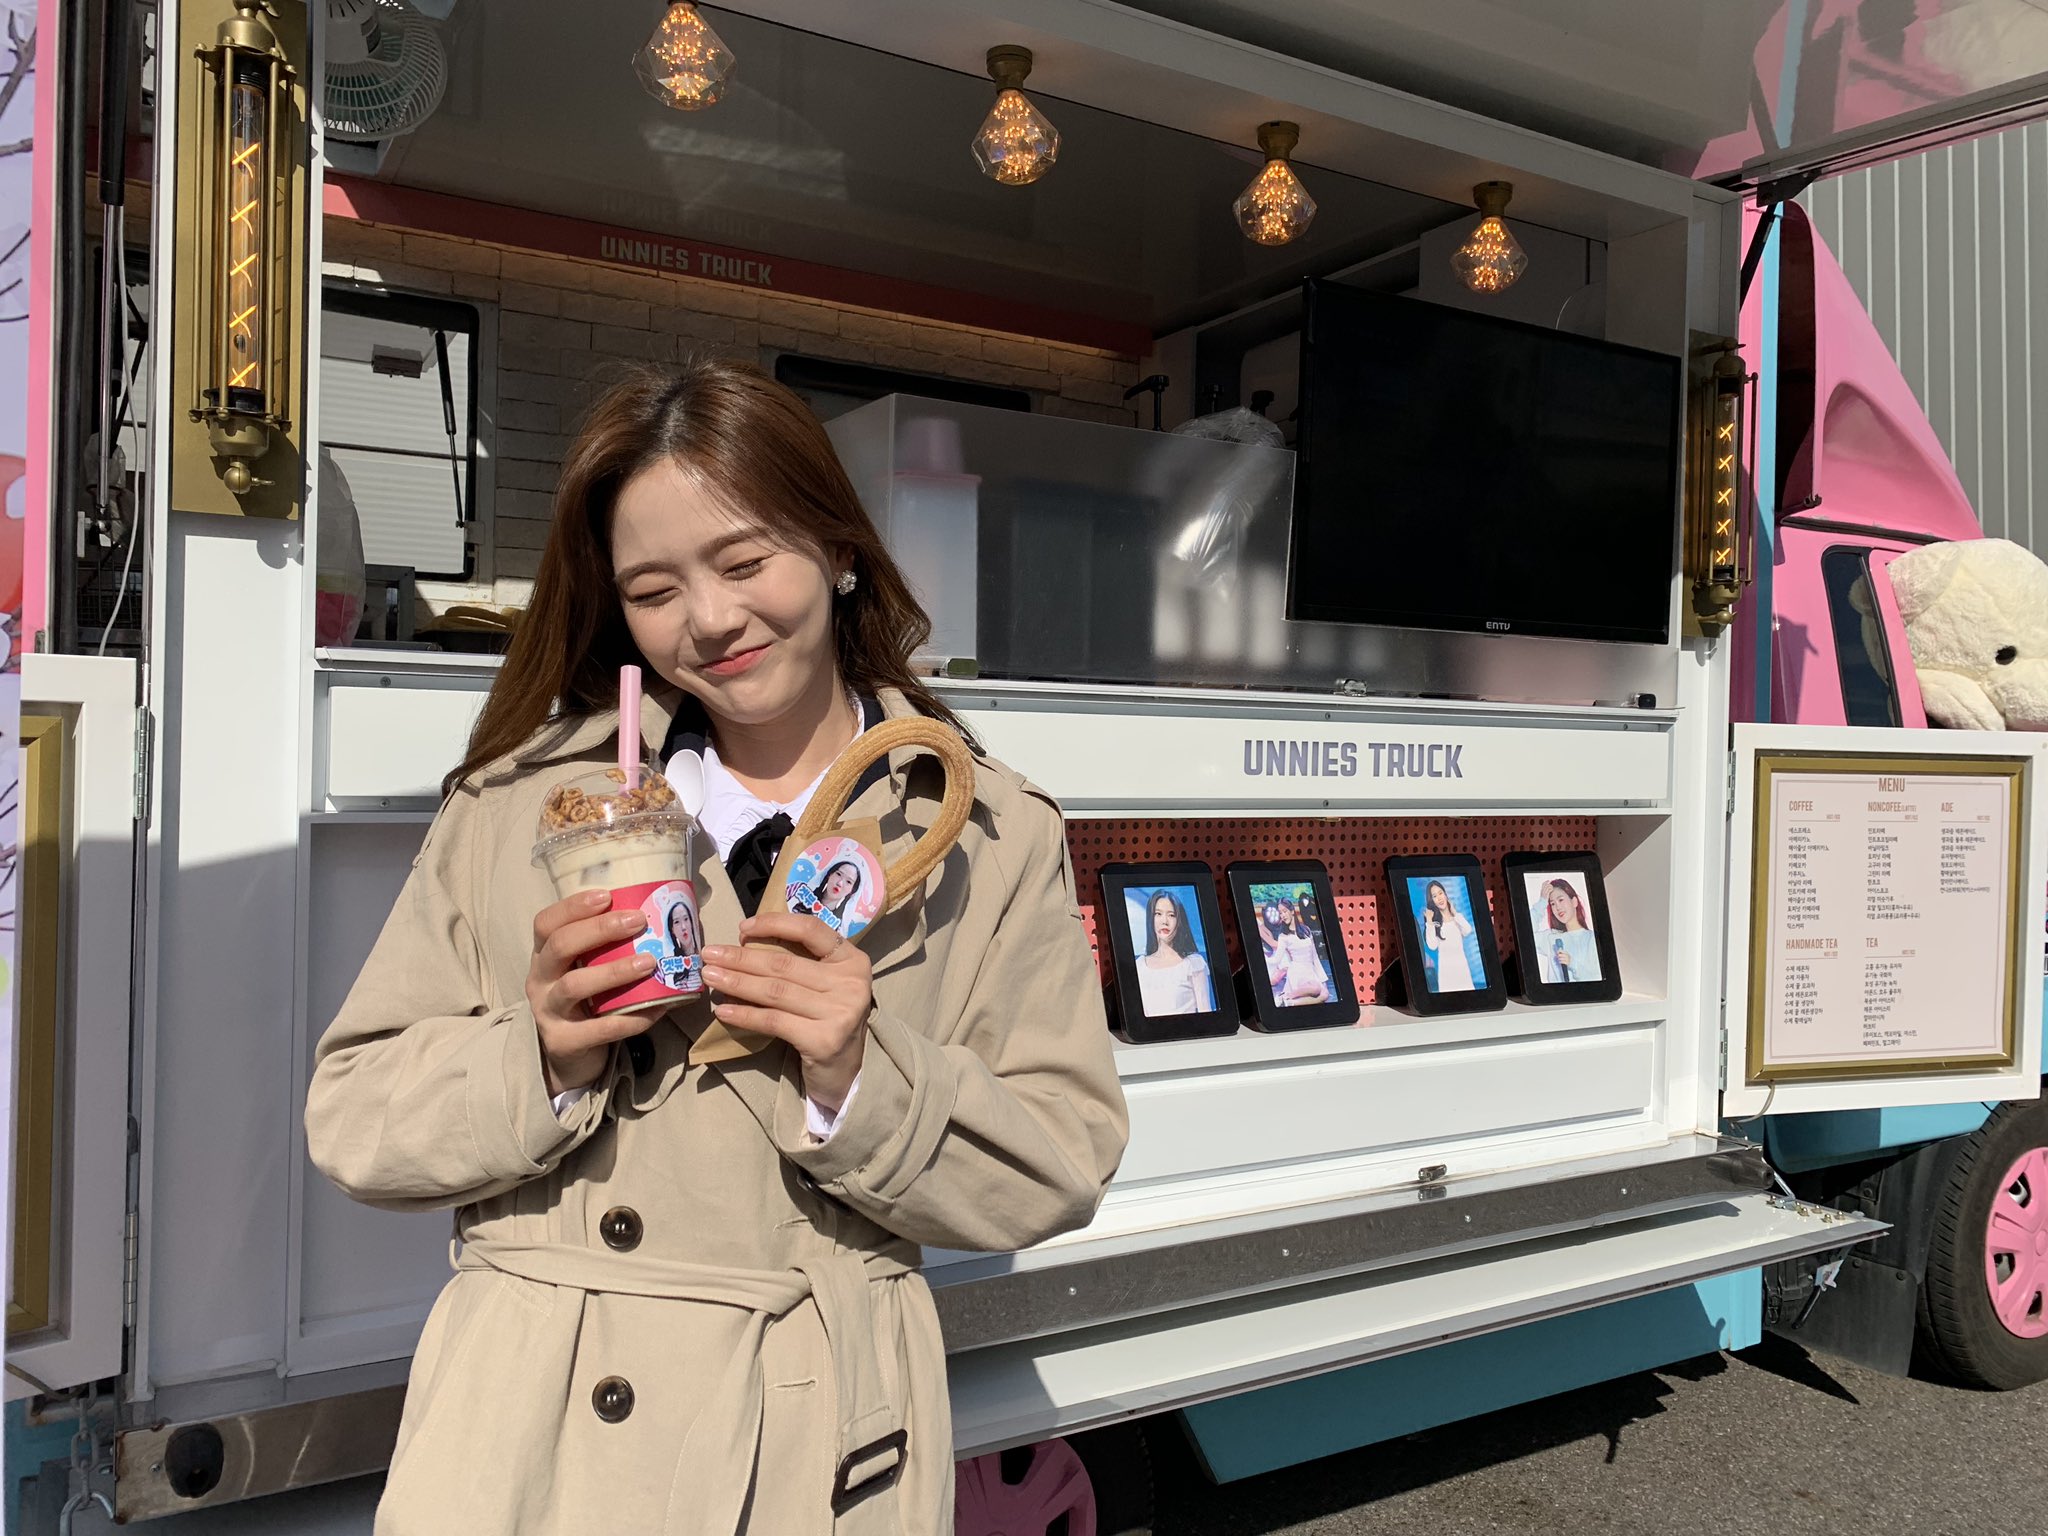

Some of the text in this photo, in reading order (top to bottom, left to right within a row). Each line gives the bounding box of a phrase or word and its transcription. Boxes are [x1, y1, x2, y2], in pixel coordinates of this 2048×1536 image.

[601, 235, 773, 286] UNNIES TRUCK
[1243, 739, 1463, 778] UNNIES TRUCK
[1878, 777, 1905, 792] MENU
[1789, 800, 1813, 811] COFFEE
[1941, 803, 1954, 813] ADE
[1786, 938, 1838, 950] HANDMADE TEA
[1866, 937, 1878, 948] TEA
